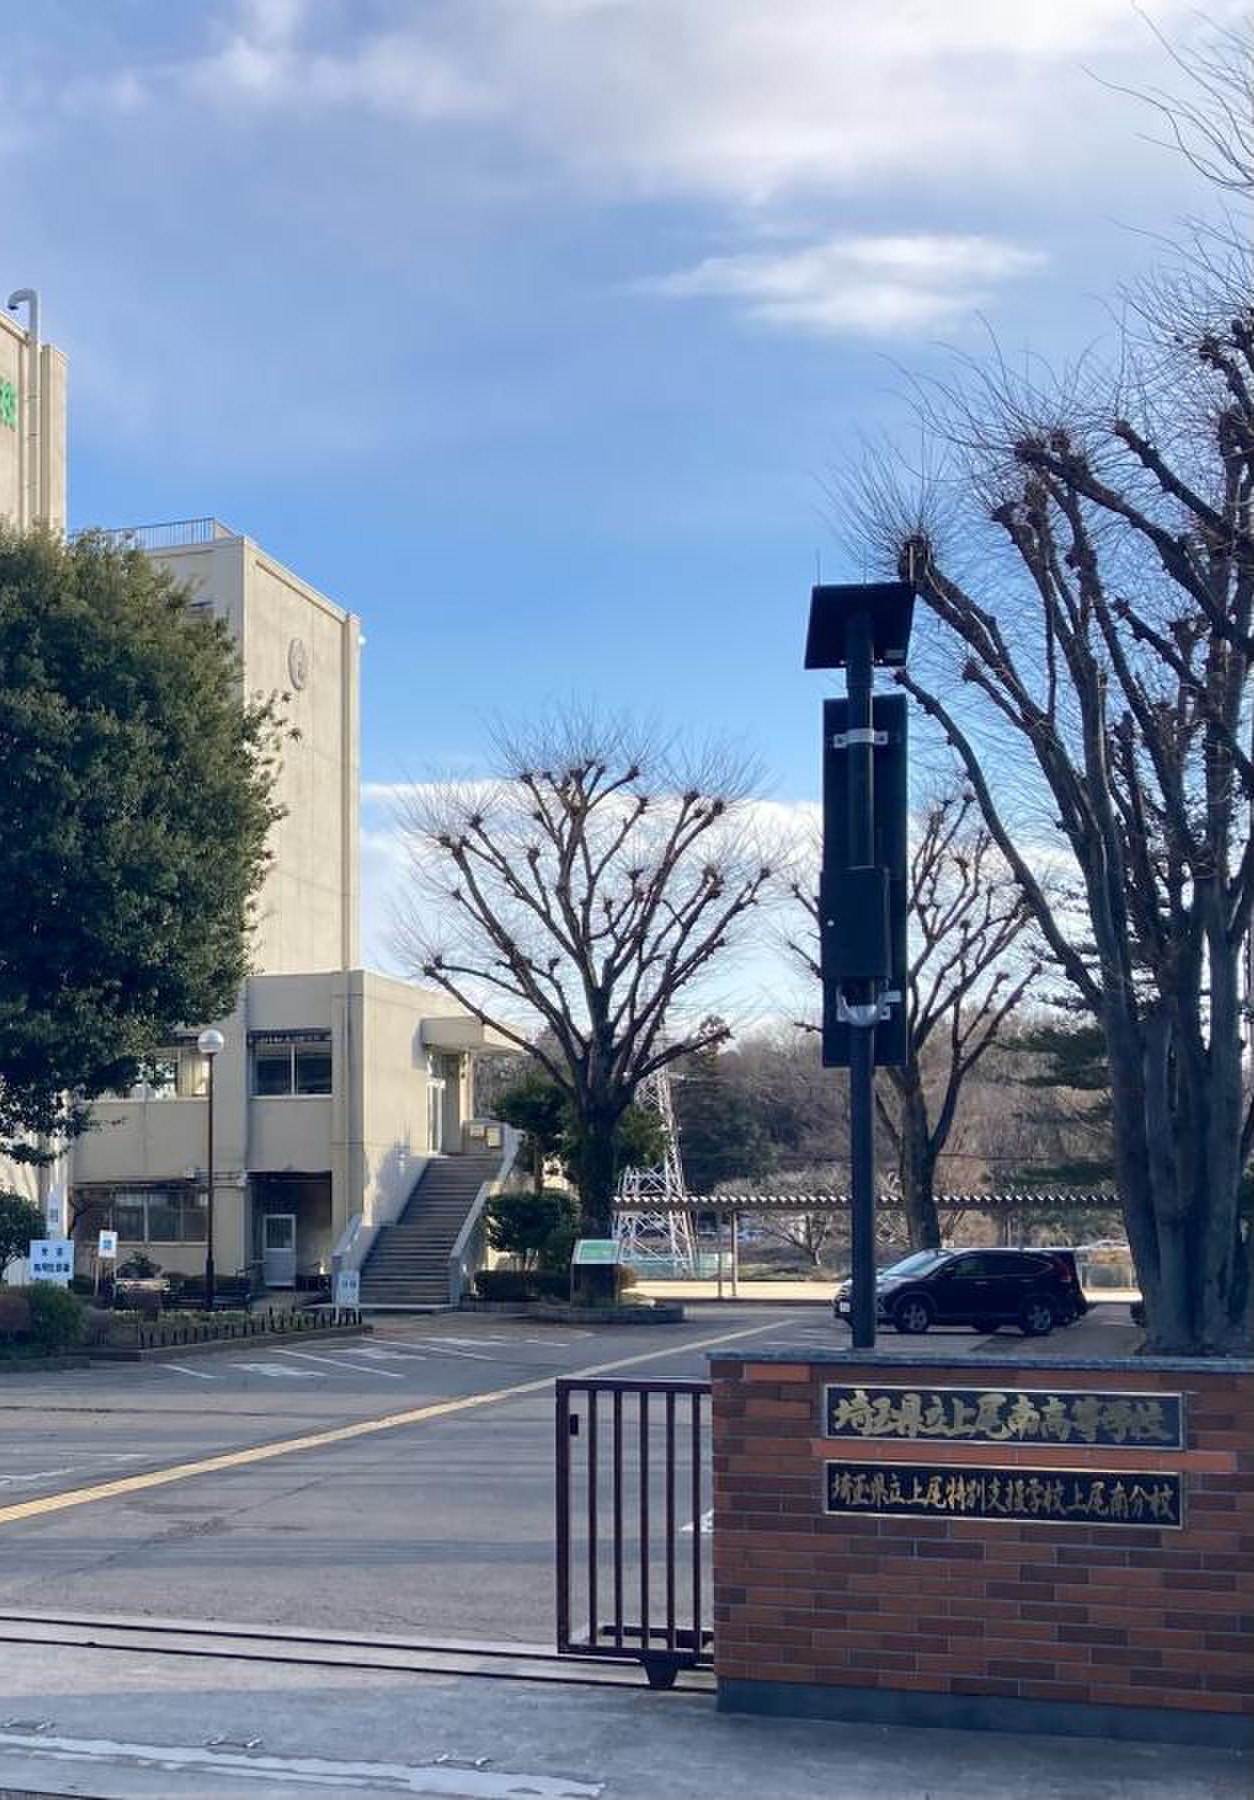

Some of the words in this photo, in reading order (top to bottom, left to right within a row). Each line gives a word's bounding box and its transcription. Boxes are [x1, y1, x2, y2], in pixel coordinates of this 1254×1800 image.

[833, 1389, 1174, 1441] 埼玉県立上尾南高等学校
[831, 1471, 1175, 1521] 埼玉県立上尾特別支援学校上尾南分校
